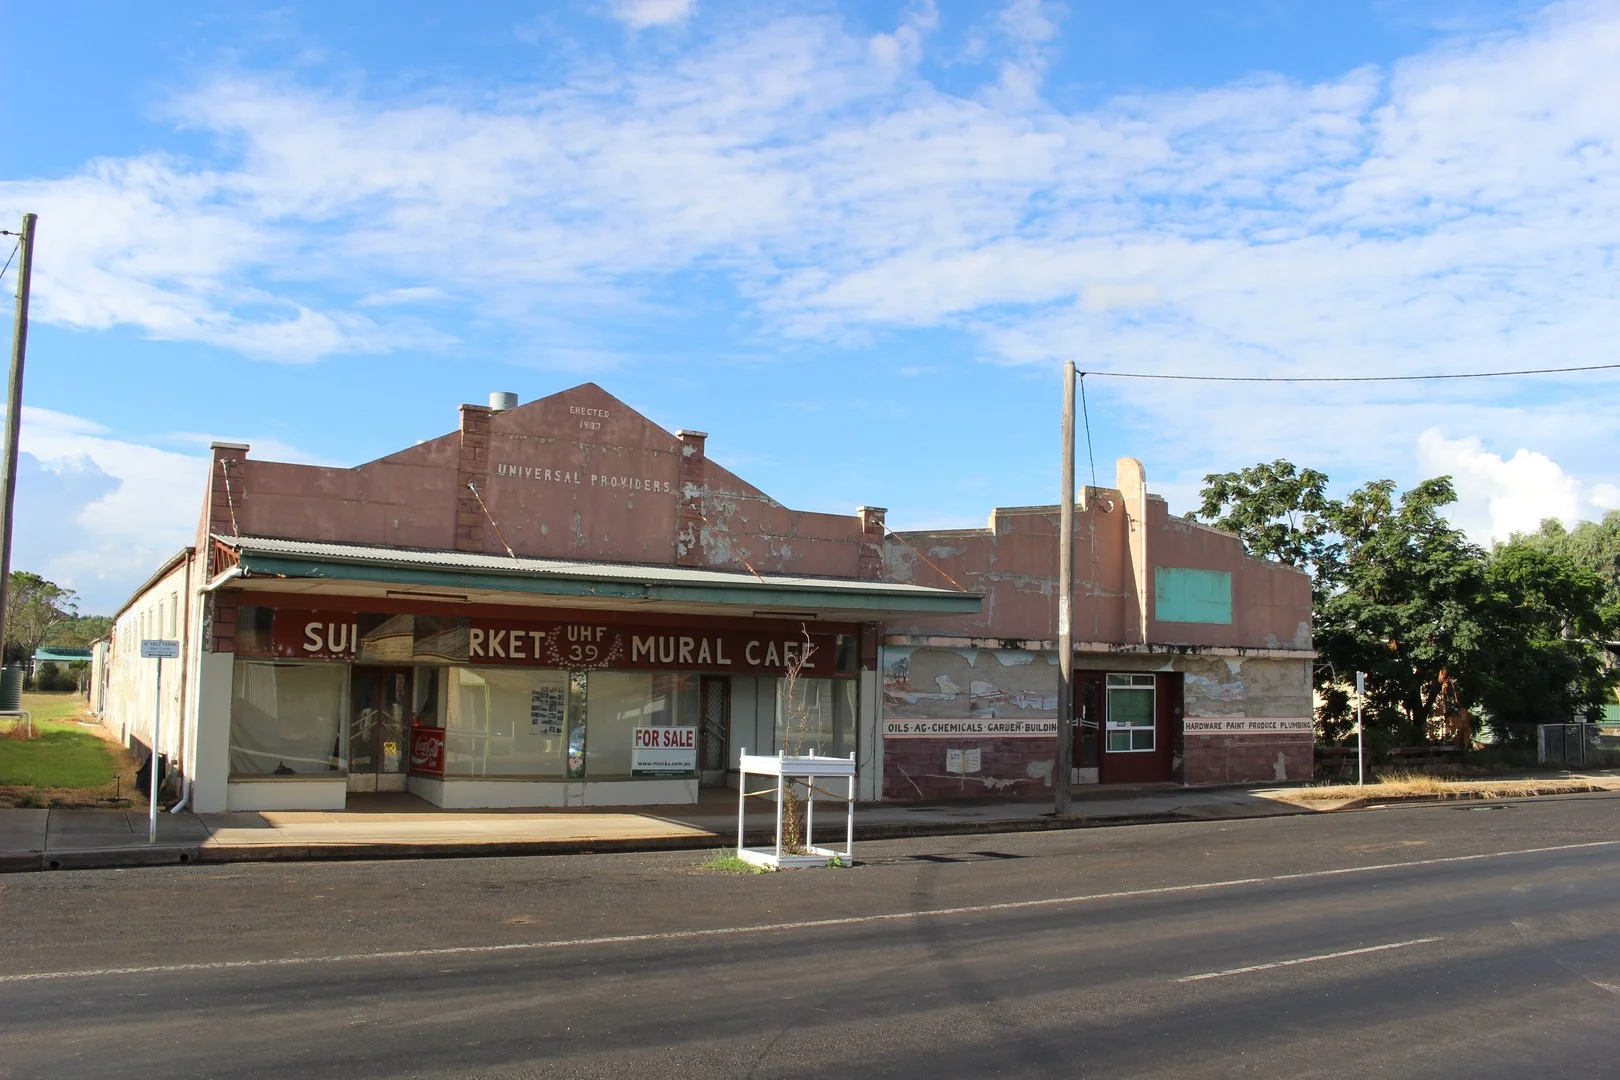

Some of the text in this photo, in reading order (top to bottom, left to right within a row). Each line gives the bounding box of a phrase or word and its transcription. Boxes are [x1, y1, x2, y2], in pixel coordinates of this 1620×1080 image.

[569, 405, 610, 418] ERECTED
[579, 420, 602, 431] 1937
[498, 463, 670, 493] UNIVERSAL PROVIDERS
[567, 625, 607, 642] UHF
[568, 644, 599, 662] 39
[631, 635, 816, 668] MURAL CAFE
[888, 722, 1058, 733] OILS AG CHEMICALS GARDEN BUILDIN
[1185, 721, 1311, 730] HARDWARE PAINT PRODUCE PLUMBING
[635, 729, 694, 747] FOR SALE
